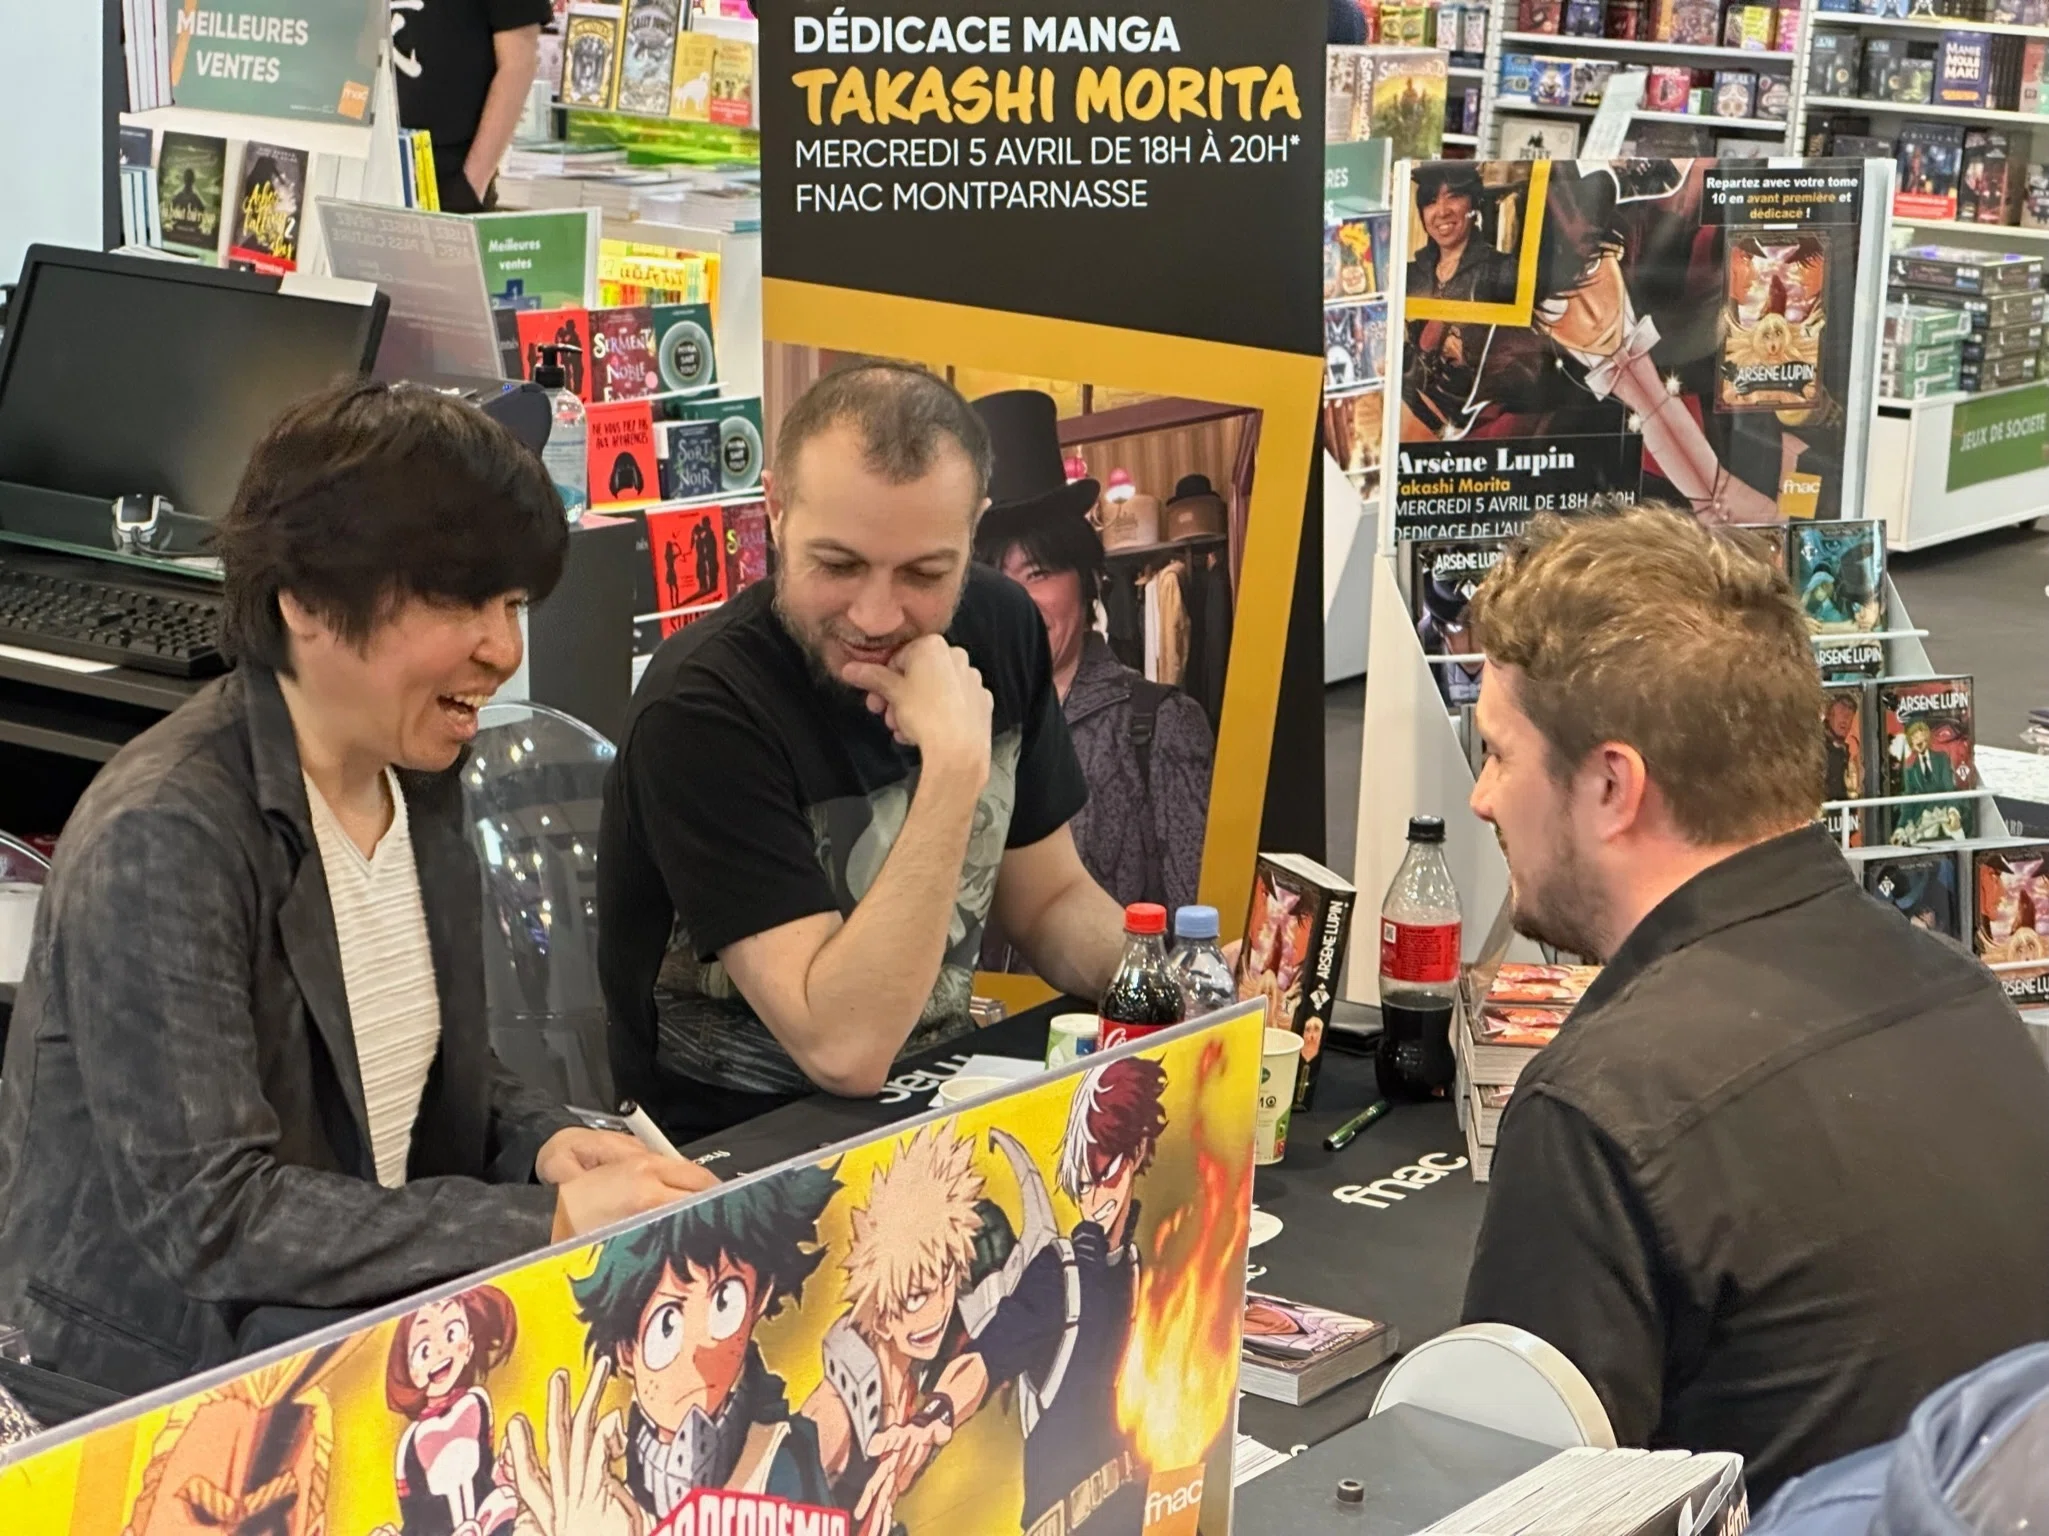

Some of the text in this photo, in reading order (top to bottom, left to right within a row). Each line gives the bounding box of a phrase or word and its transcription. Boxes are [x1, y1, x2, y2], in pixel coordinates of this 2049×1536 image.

[176, 9, 309, 46] MEILLEURES
[794, 8, 1011, 53] DÉDICACE
[1024, 17, 1181, 53] MANGA
[196, 50, 281, 84] VENTES
[791, 63, 1302, 126] TAKASHI MORITA
[796, 138, 959, 169] MERCREDI
[968, 138, 987, 166] 5
[995, 136, 1081, 166] AVRIL
[1091, 136, 1131, 165] DE
[1139, 135, 1190, 165] 18H
[1199, 128, 1222, 164] À
[796, 179, 1148, 213] FNAC MONTPARNASSE
[1706, 176, 1858, 190] Repartez avec votre tome
[1712, 192, 1851, 205] 10 en avant première et
[488, 238, 541, 253] Meilleures
[499, 258, 532, 271] ventes
[1781, 363, 1815, 380] LUPIN
[1960, 427, 1987, 451] JEUX
[1990, 422, 2004, 443] DE
[1398, 445, 1575, 477] Arsène Lupin
[1458, 477, 1511, 493] Morita
[1783, 479, 1821, 495] fnac
[1395, 497, 1471, 516] MERCREDI
[1475, 497, 1484, 513] 5
[1488, 495, 1530, 512] AVRIL
[1535, 494, 1555, 511] DE
[1560, 492, 1588, 509] 18H
[1853, 646, 1882, 664] LUPIN
[1940, 692, 1968, 709] LUPIN
[1329, 900, 1344, 935] LUPIN
[1332, 1152, 1468, 1209] fnac
[1145, 1479, 1204, 1527] fnac
